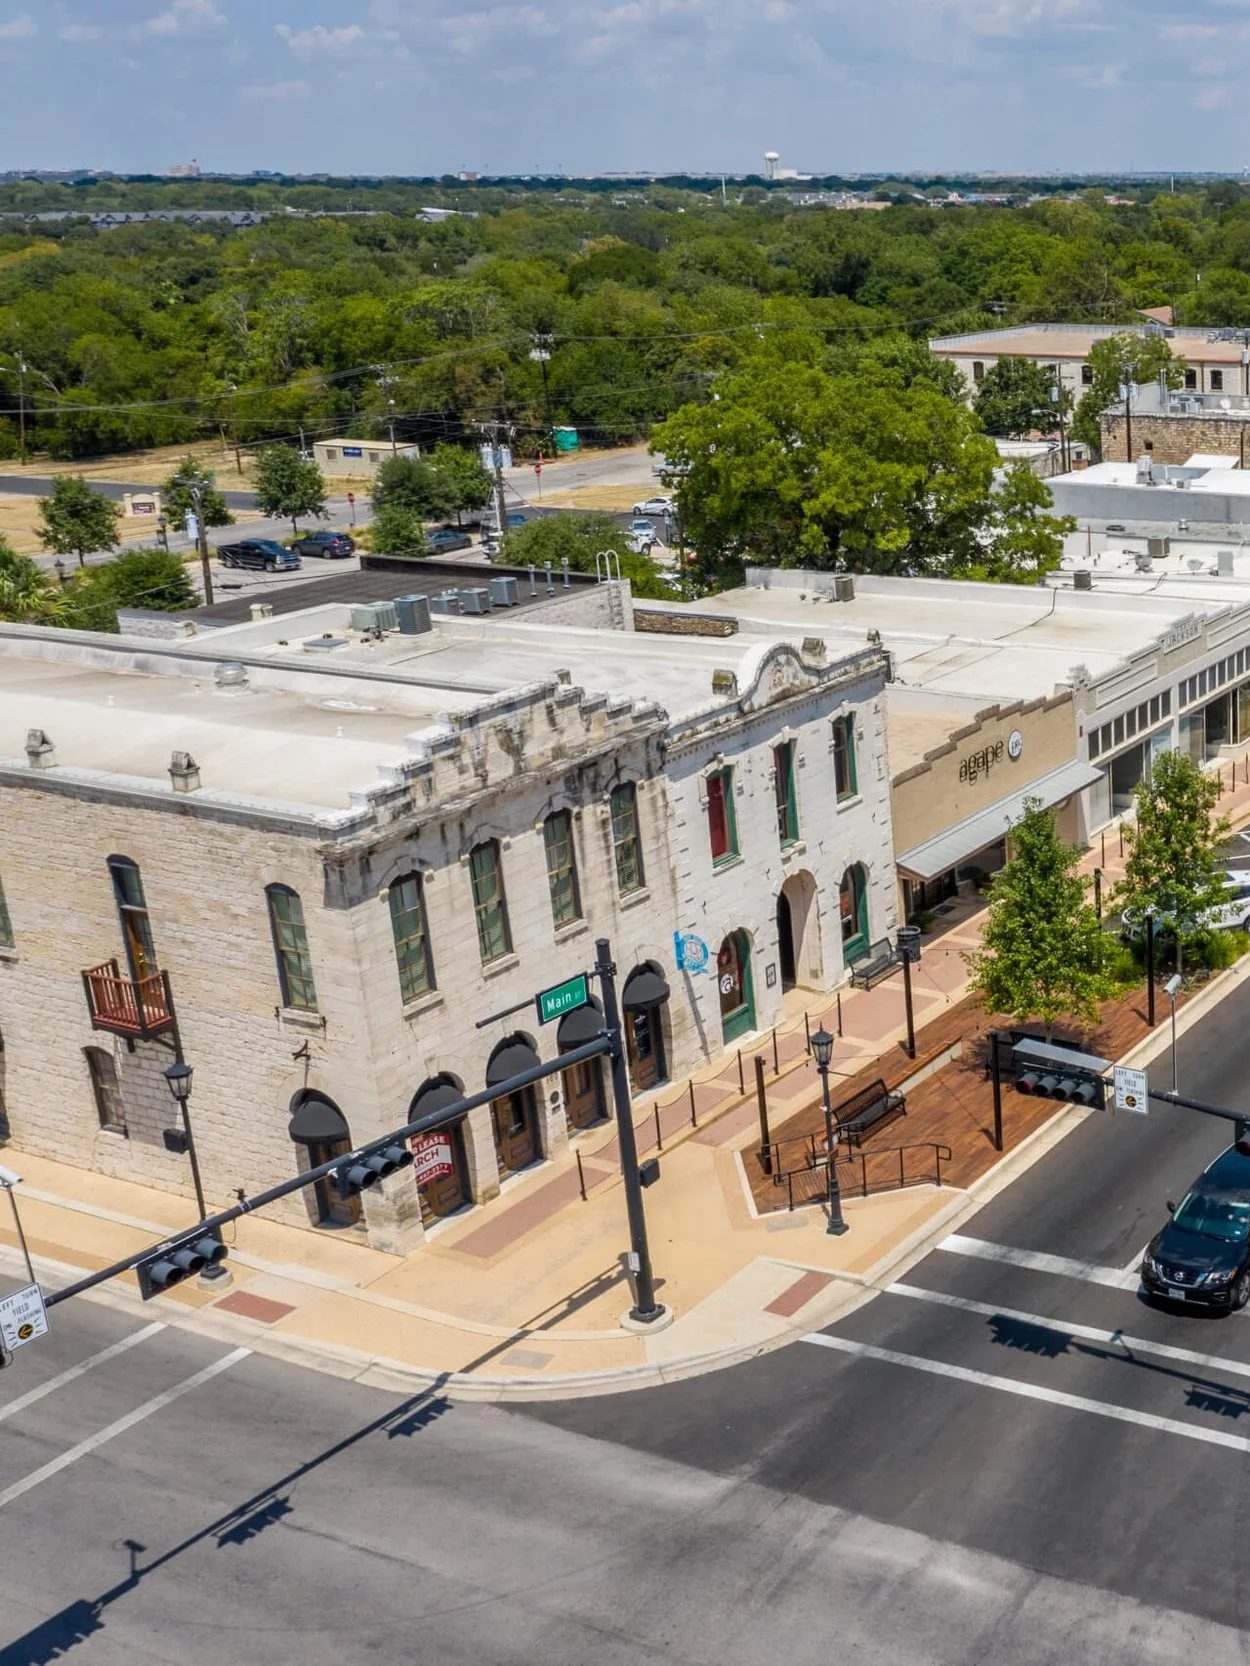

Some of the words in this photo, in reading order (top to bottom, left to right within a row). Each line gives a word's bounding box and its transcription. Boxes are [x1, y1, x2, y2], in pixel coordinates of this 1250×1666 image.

[959, 741, 1004, 783] agape
[547, 993, 572, 1012] Main
[419, 1135, 446, 1152] LEASE
[21, 1288, 38, 1300] TURN
[12, 1302, 30, 1316] YIELD
